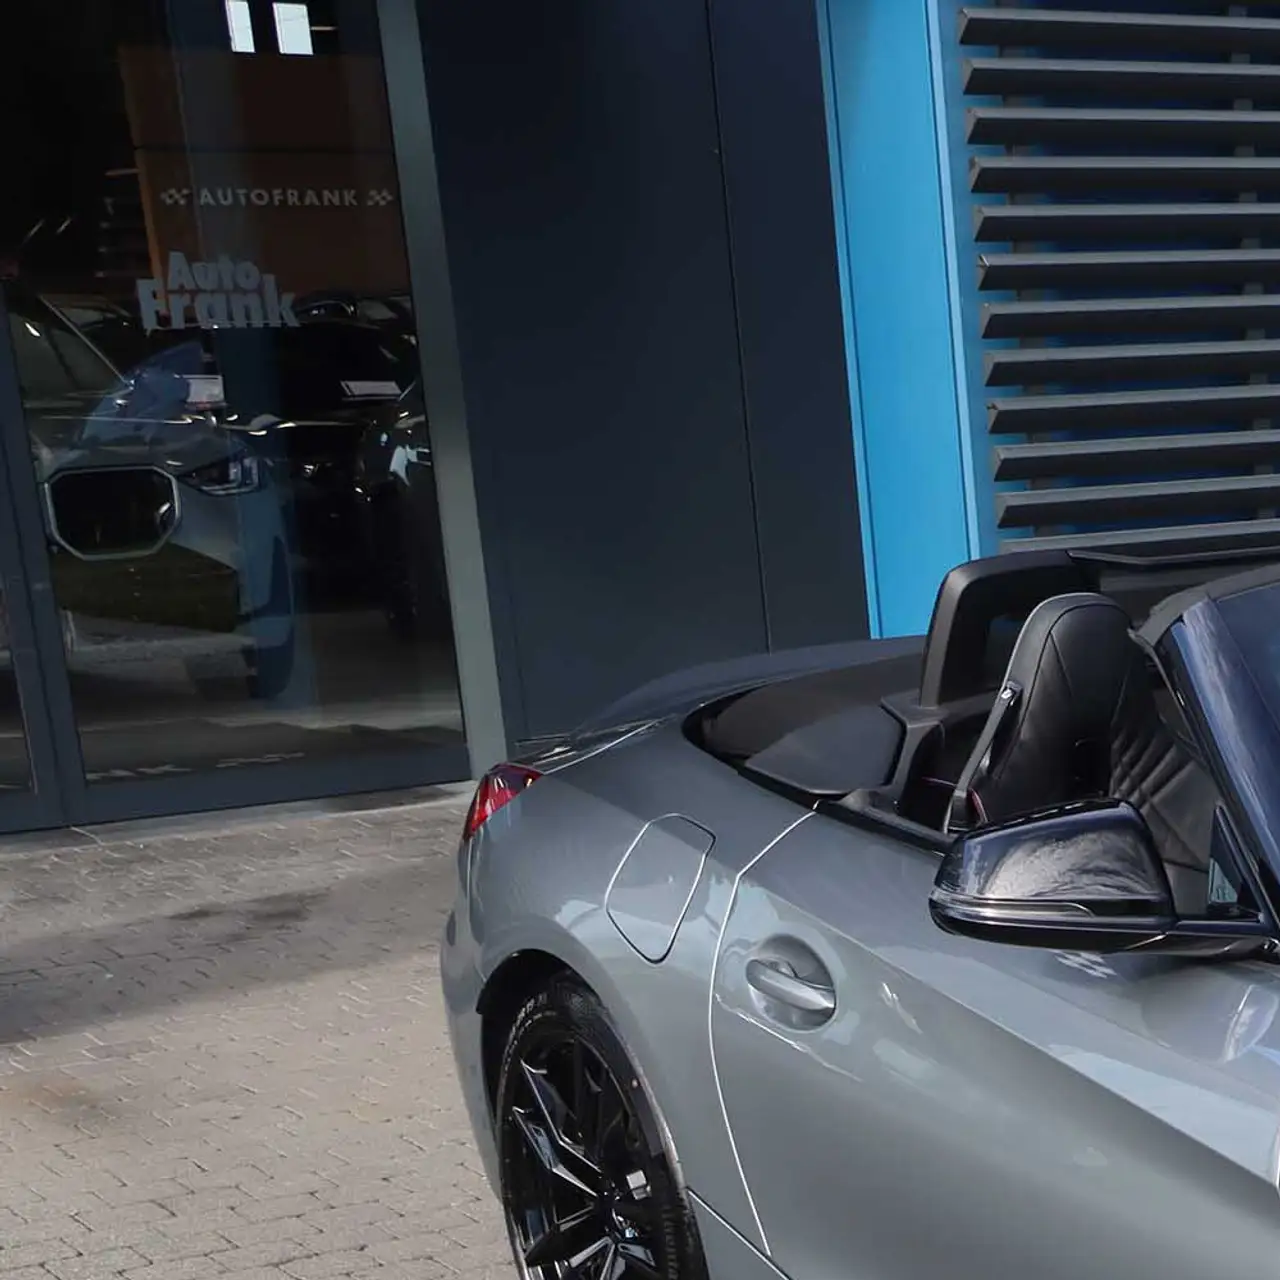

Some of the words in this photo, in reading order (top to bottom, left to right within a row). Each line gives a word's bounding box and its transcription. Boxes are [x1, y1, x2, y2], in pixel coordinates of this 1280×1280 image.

[200, 187, 359, 206] AUTOFRANK
[167, 250, 262, 291] Auto
[136, 273, 301, 330] Frank
